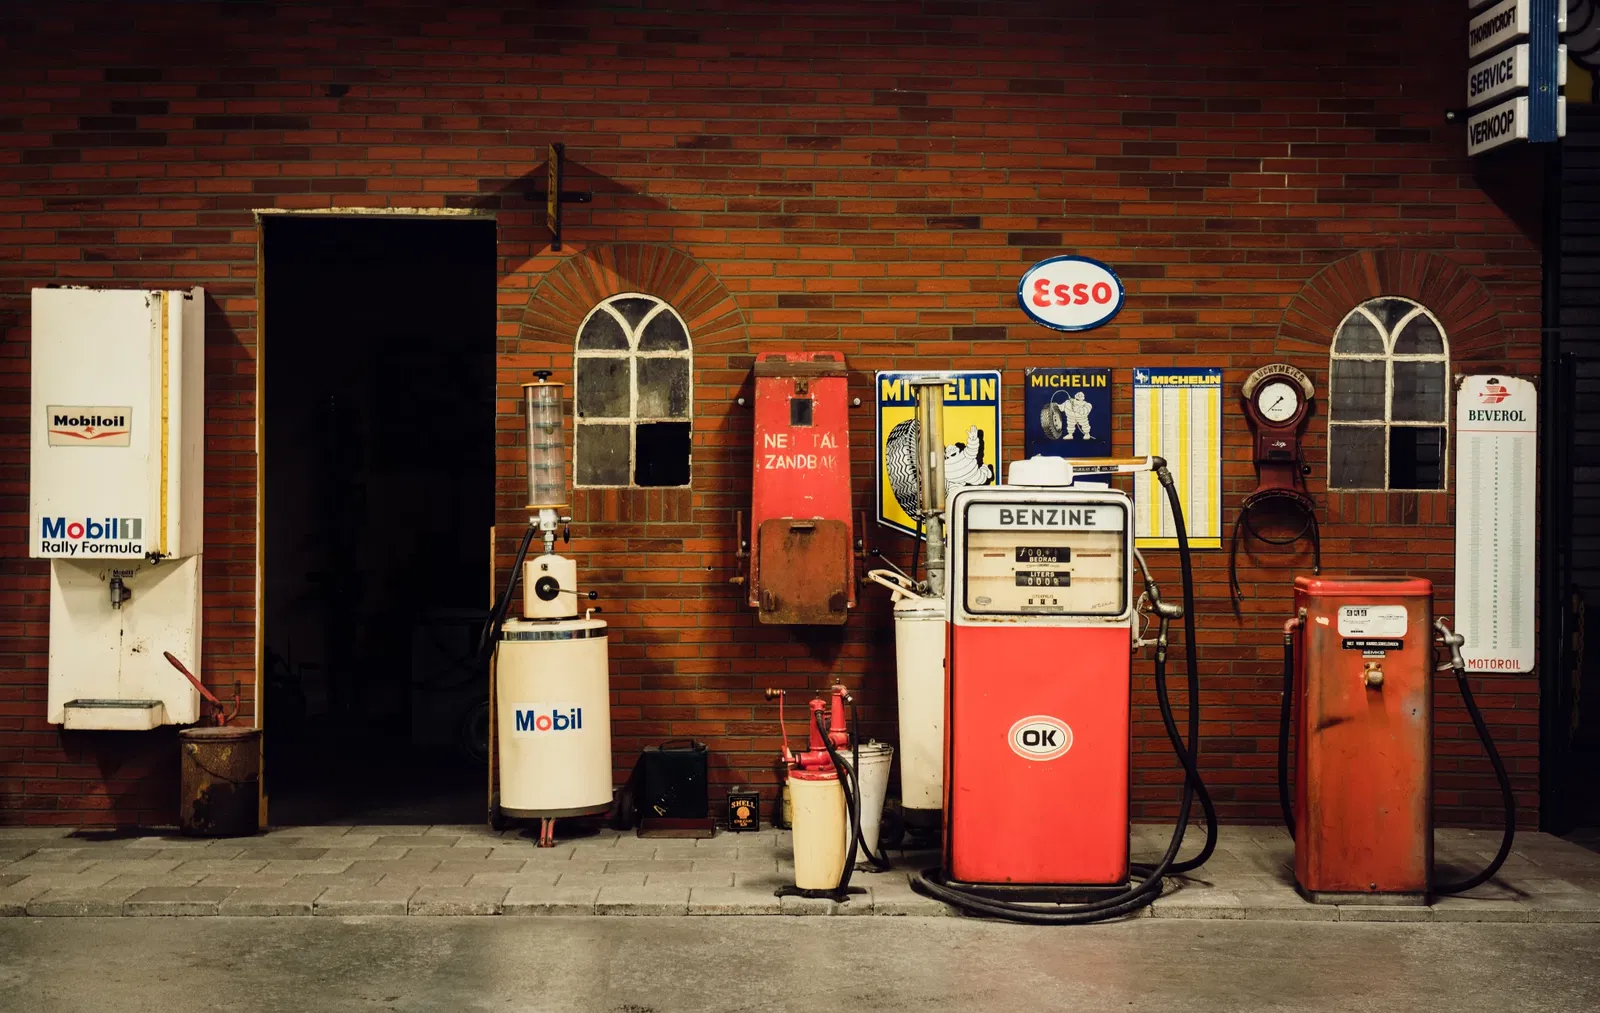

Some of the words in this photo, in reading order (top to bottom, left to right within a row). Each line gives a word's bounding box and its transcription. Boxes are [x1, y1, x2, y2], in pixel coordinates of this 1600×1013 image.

[1470, 6, 1516, 46] THORNYCROFT
[1470, 57, 1513, 97] SERVICE
[1470, 109, 1514, 146] VERKOOP
[1031, 374, 1106, 387] MICHELIN
[1151, 375, 1221, 384] MICHELIN
[881, 378, 996, 401] MIELIN
[54, 415, 125, 427] Mobiloil
[1468, 410, 1526, 422] BEVEROL
[1000, 509, 1096, 526] BENZINE
[42, 517, 118, 540] Mobil
[42, 541, 78, 555] Rally
[82, 541, 142, 554] Formula
[1468, 658, 1521, 670] MOTOROIL
[515, 707, 582, 732] Mobil
[1022, 729, 1057, 747] OK
[731, 800, 756, 809] SHELL
